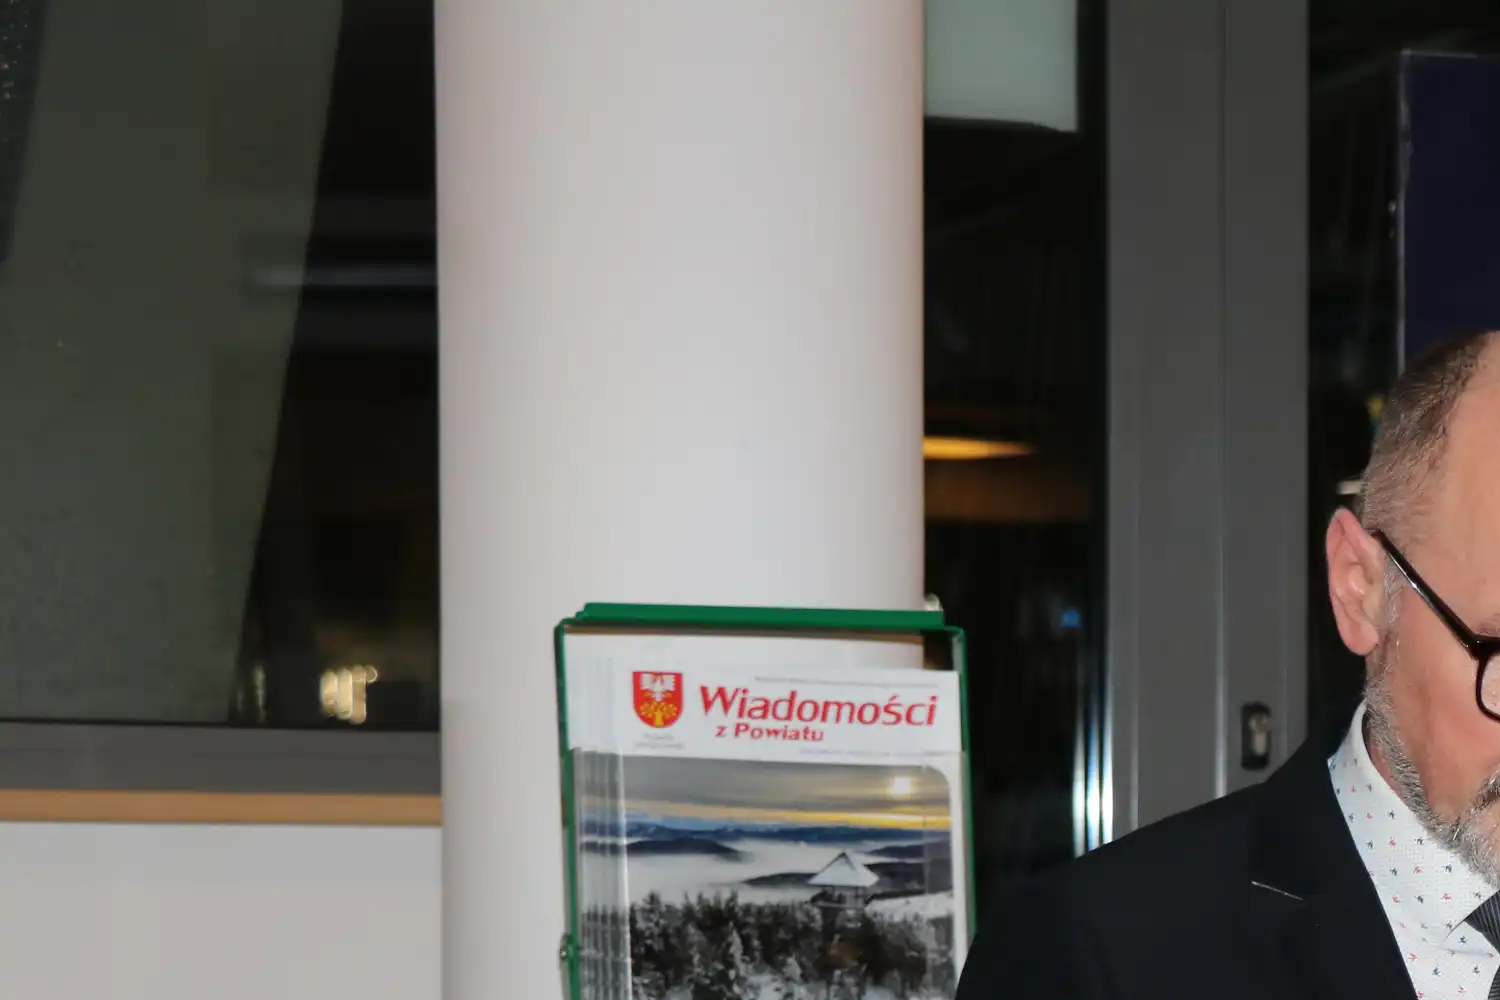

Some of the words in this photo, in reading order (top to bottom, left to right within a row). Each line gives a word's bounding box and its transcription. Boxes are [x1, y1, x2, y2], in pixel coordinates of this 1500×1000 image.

[699, 684, 939, 727] Wiadomości
[715, 725, 727, 738] z
[733, 722, 825, 743] Powiatu
